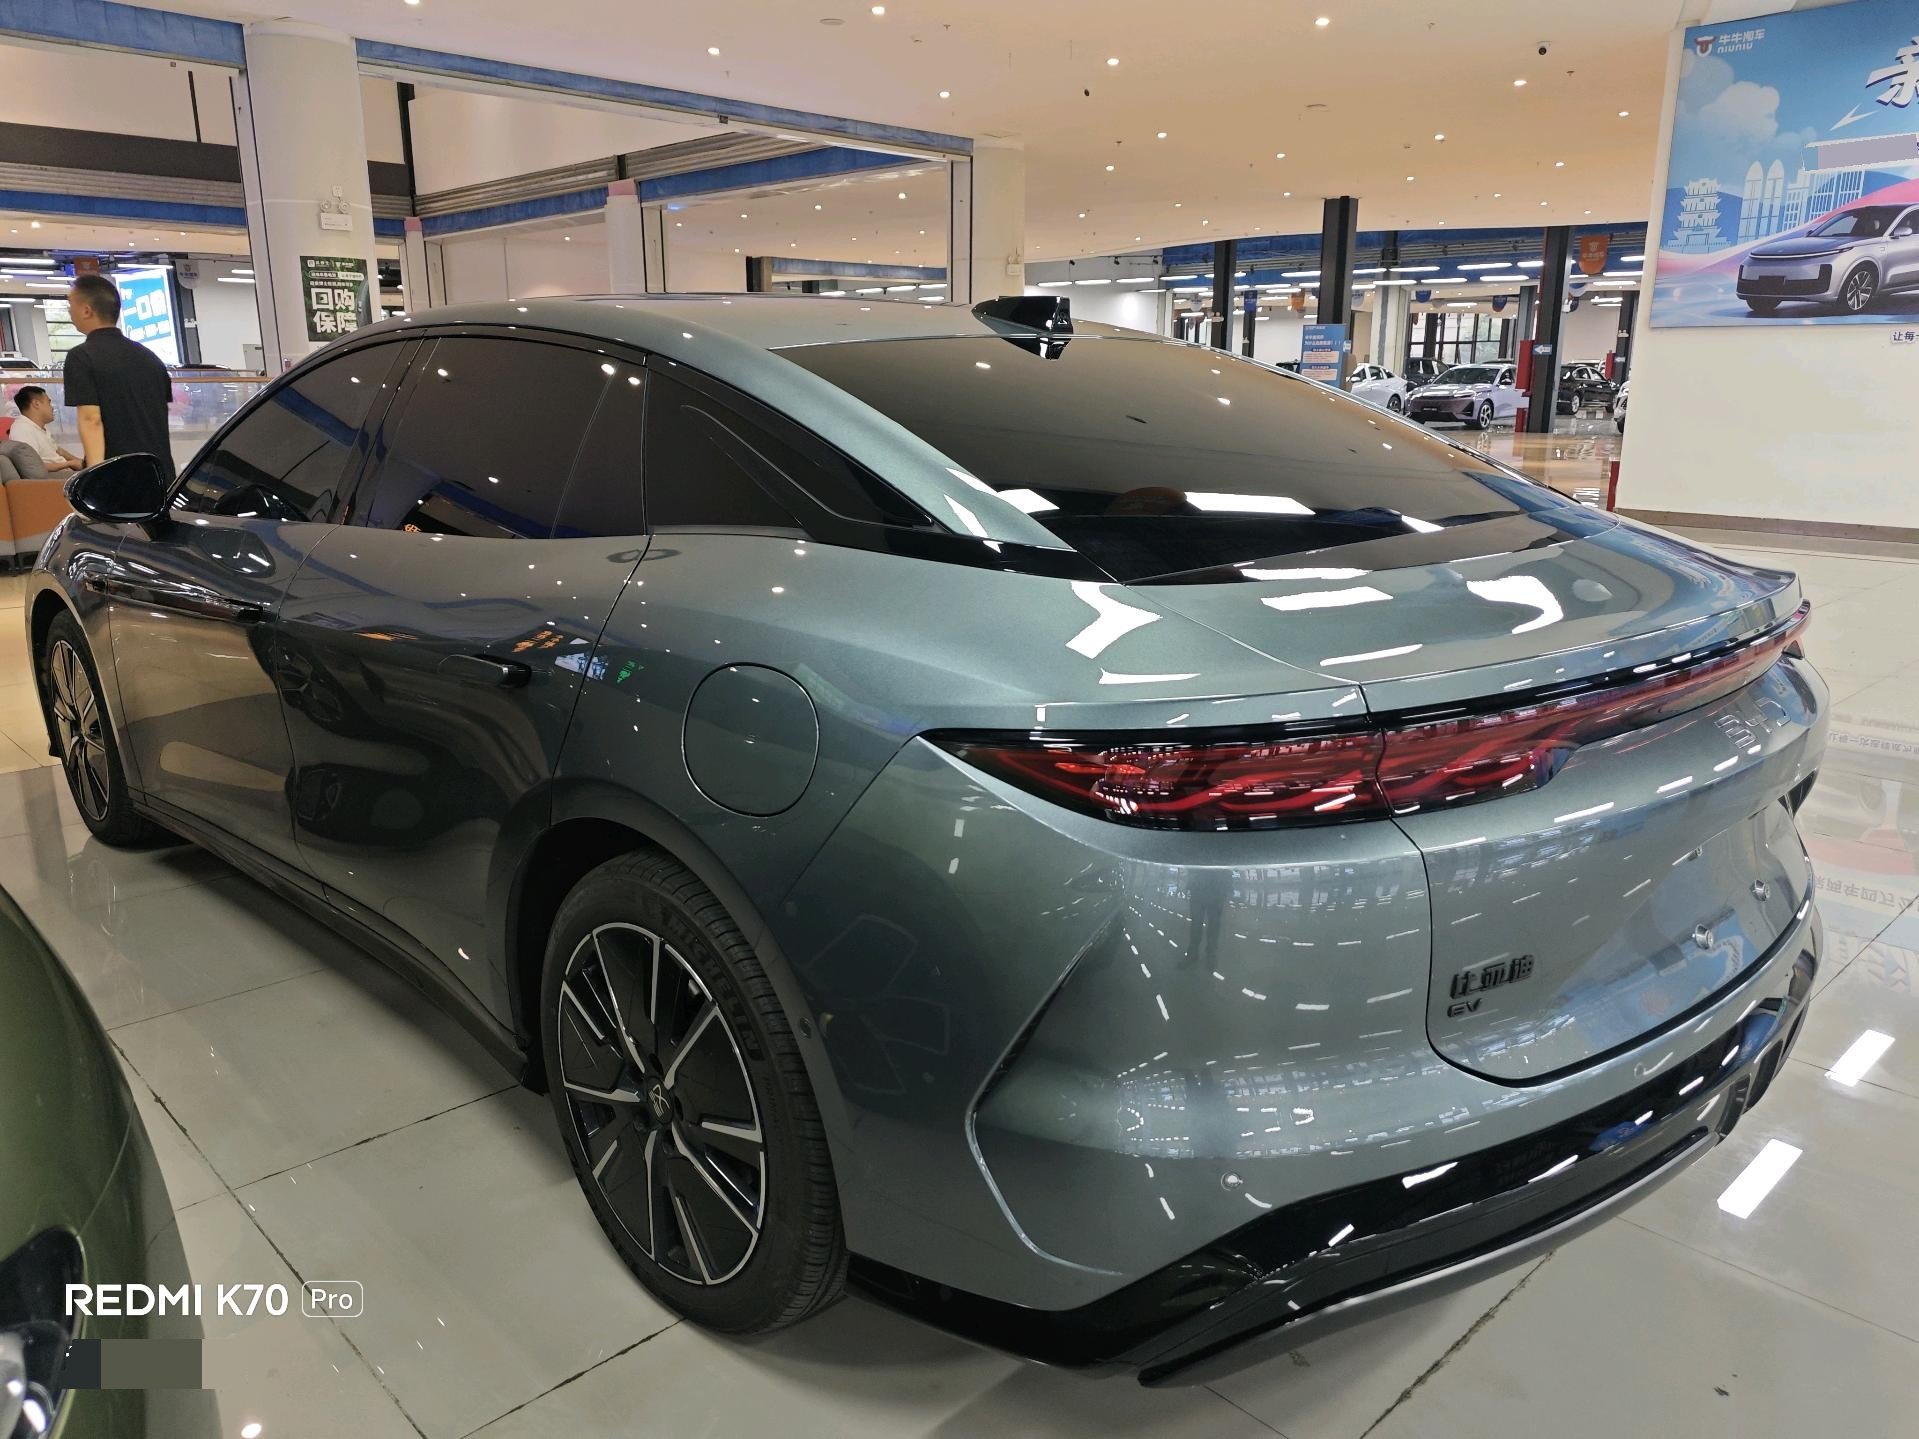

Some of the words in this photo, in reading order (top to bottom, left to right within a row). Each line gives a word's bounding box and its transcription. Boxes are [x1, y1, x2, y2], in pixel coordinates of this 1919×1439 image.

[311, 287, 355, 311] 回购
[313, 310, 358, 334] 保障
[1713, 696, 1792, 749] BYD
[1449, 954, 1535, 1000] 比亚迪
[1447, 998, 1482, 1018] EV
